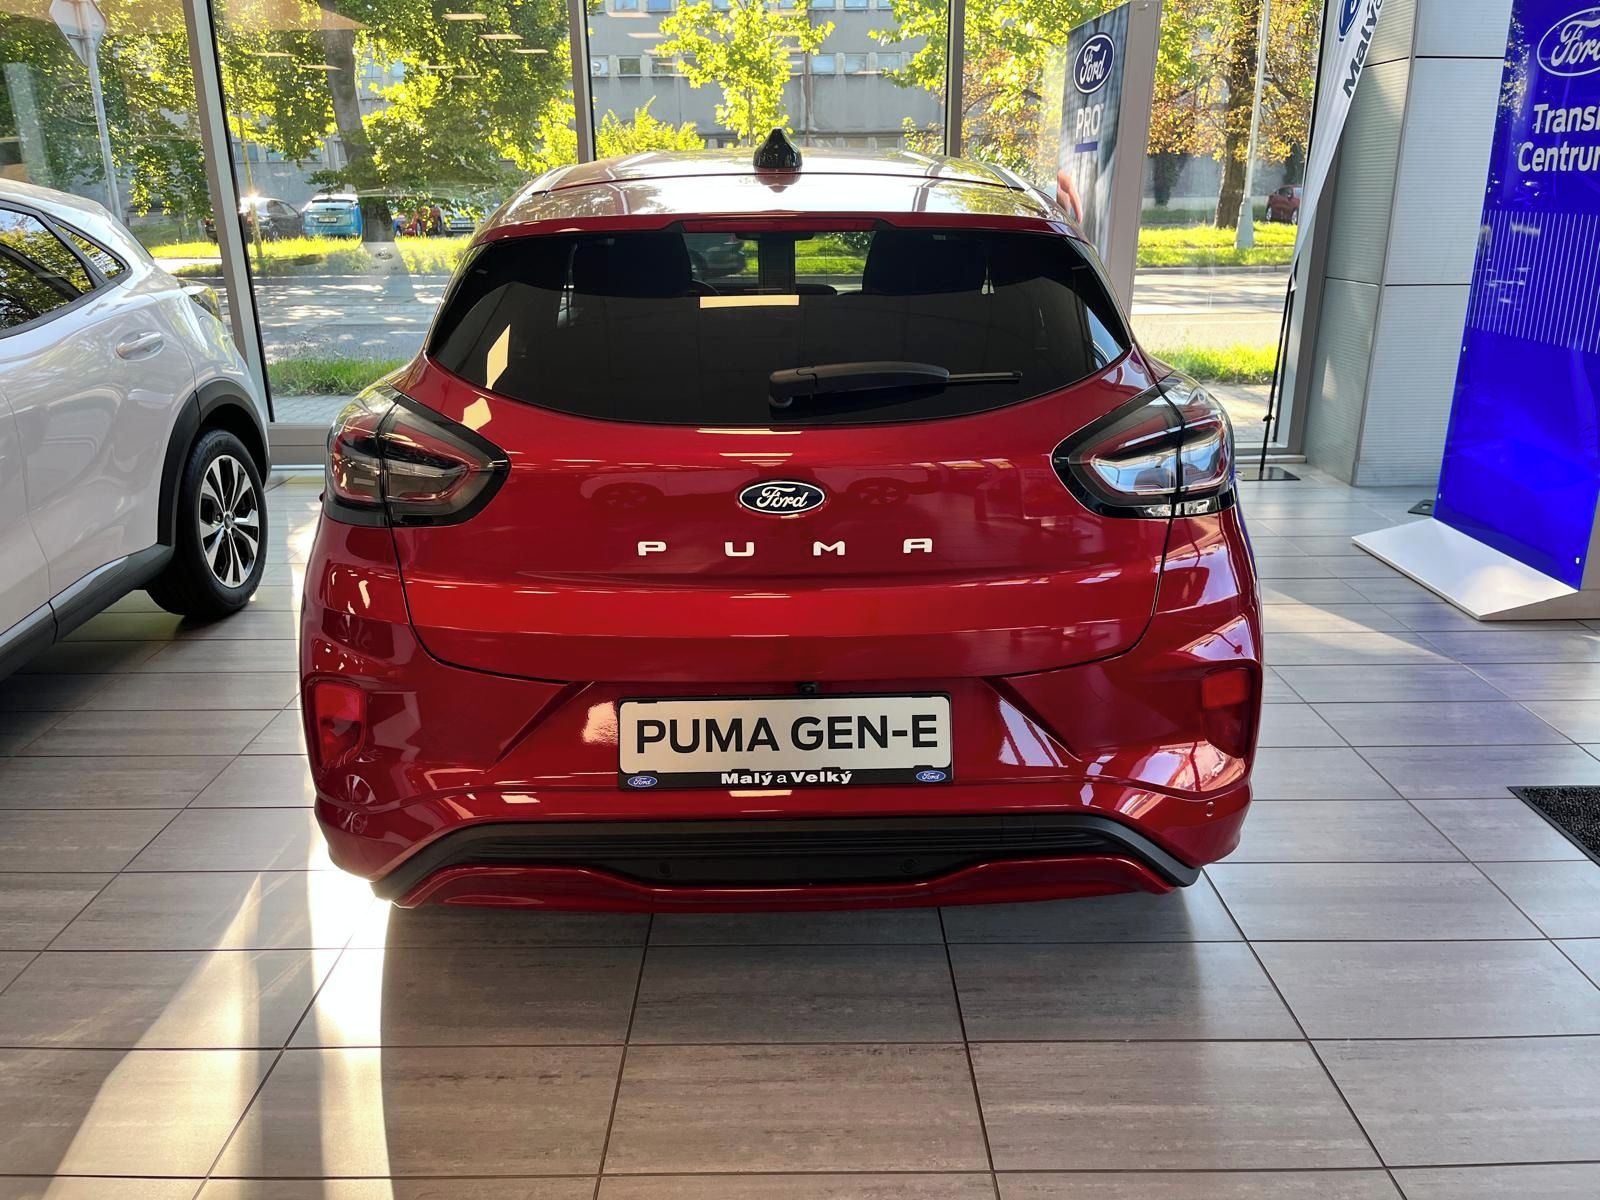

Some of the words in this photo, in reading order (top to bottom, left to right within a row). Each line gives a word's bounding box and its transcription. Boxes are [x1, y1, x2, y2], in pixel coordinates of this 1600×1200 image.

[1080, 43, 1107, 84] Ford
[1075, 104, 1101, 138] PRO
[756, 486, 809, 508] Ford
[637, 538, 933, 557] PUMA
[636, 717, 780, 754] PUMA
[790, 714, 938, 750] GEN-E
[720, 771, 773, 786] Malý
[776, 774, 787, 784] a
[790, 770, 852, 784] Velký
